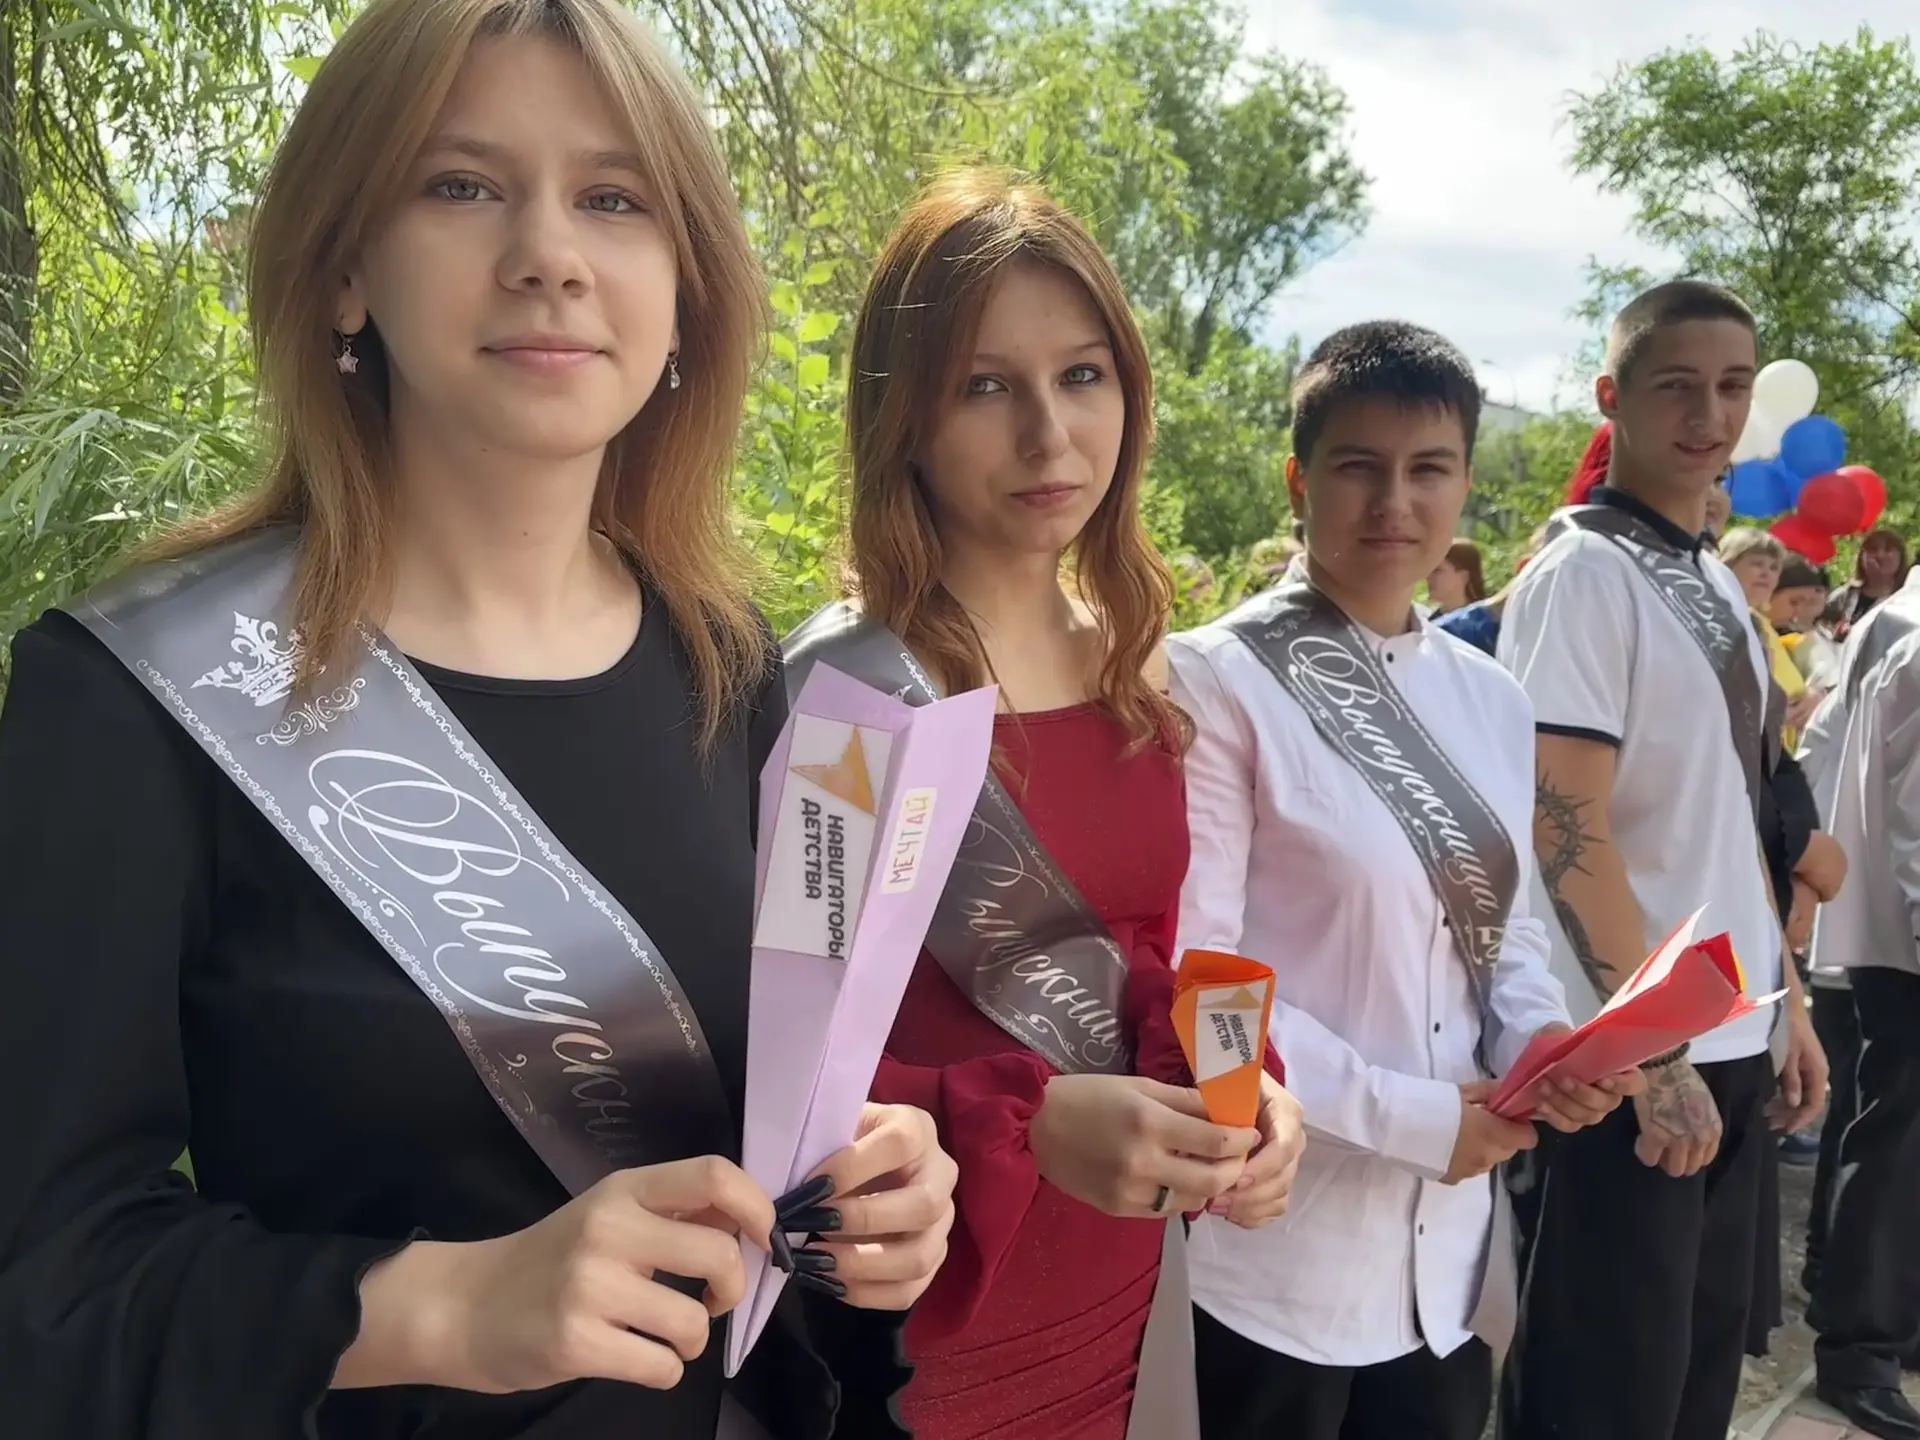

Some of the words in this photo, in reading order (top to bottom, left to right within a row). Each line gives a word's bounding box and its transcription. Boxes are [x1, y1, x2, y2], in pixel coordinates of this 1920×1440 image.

[1288, 636, 1500, 914] Выпускница
[801, 798, 822, 900] ДЕТСТВА
[827, 814, 846, 961] НАВИГАТОРЫ
[889, 795, 929, 885] МЕЧТАЙ
